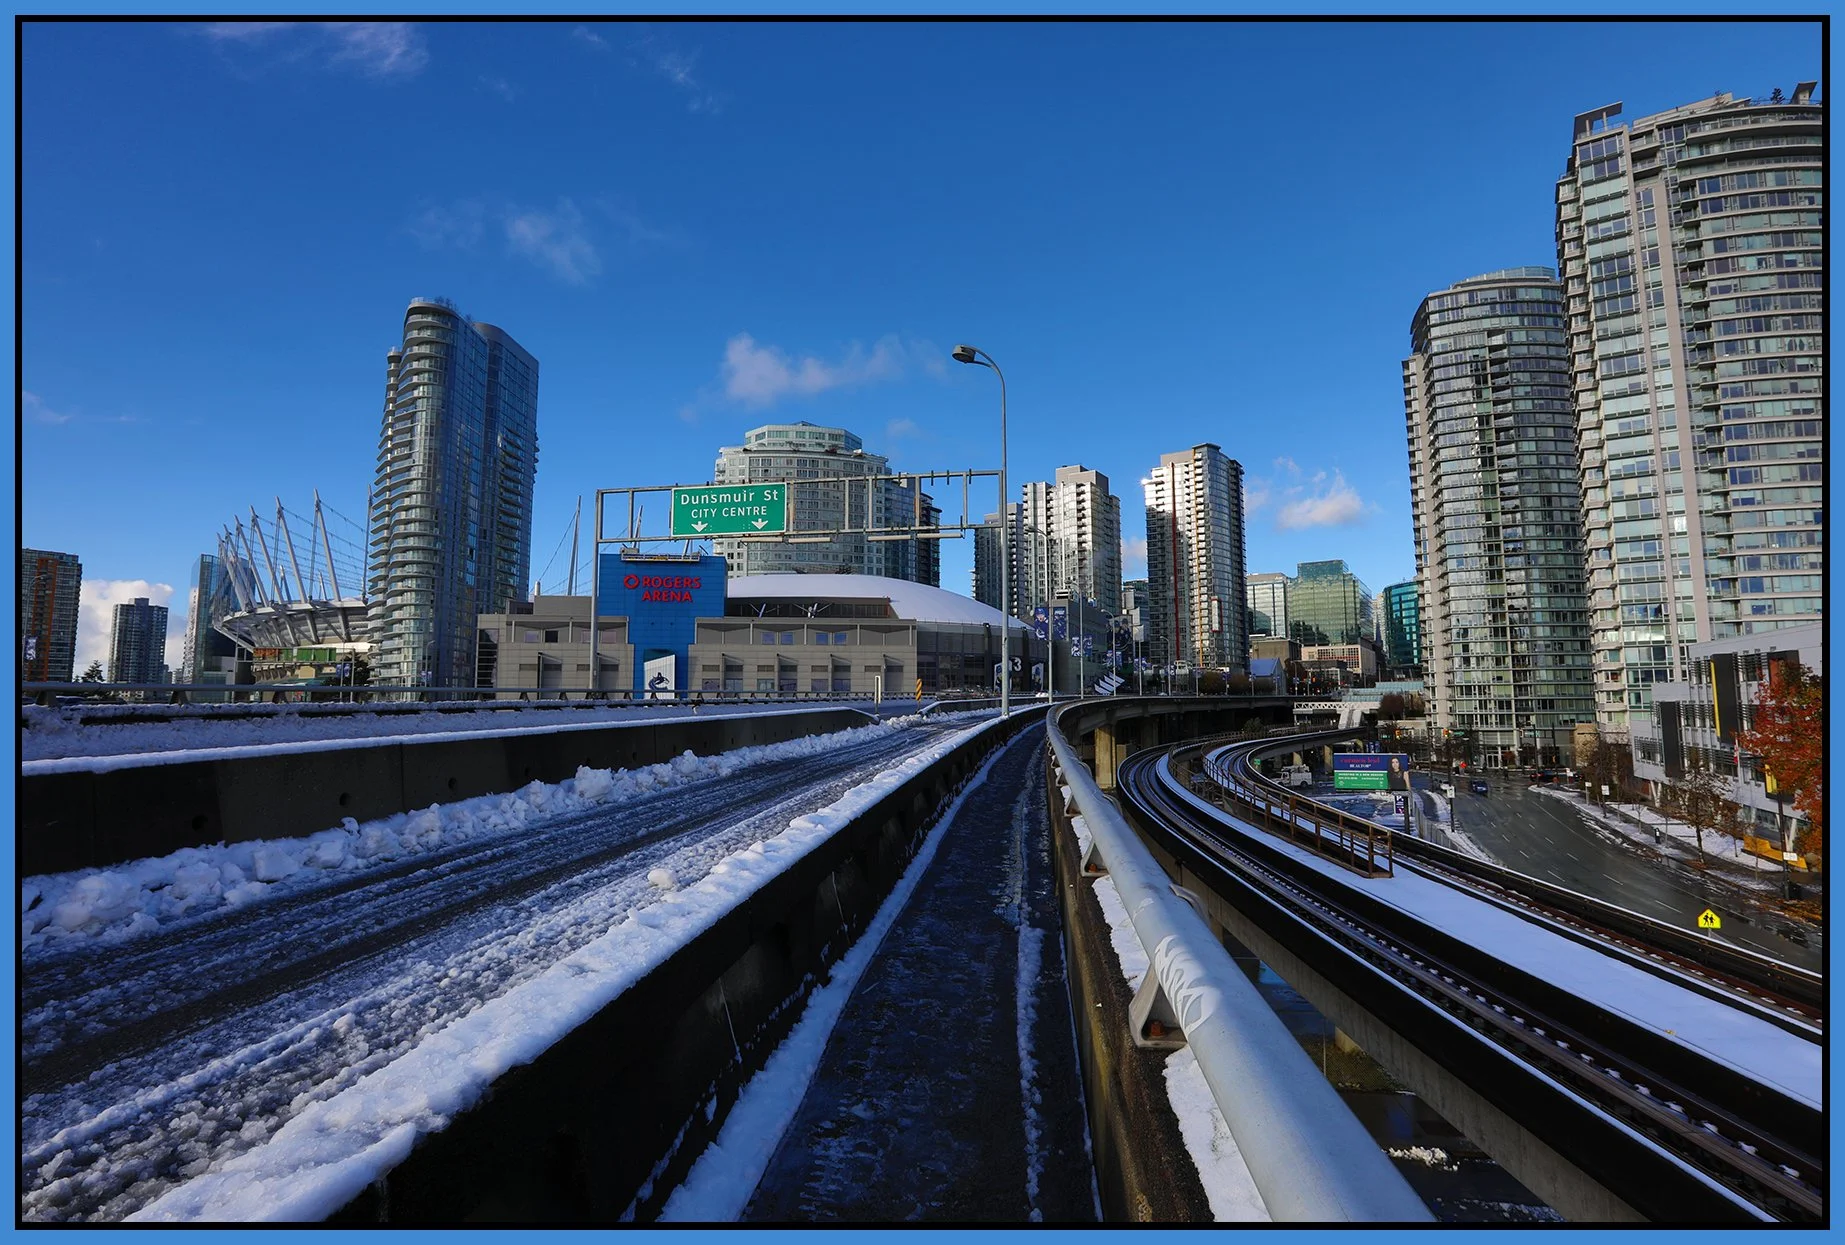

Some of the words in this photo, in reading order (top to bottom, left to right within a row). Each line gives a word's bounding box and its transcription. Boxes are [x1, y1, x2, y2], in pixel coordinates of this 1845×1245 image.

[681, 490, 755, 505] Dunsmuir
[764, 489, 779, 501] St
[691, 508, 717, 519] CITY
[722, 506, 767, 517] CENTRE
[642, 576, 701, 589] ROGERS
[642, 590, 693, 602] ARENA
